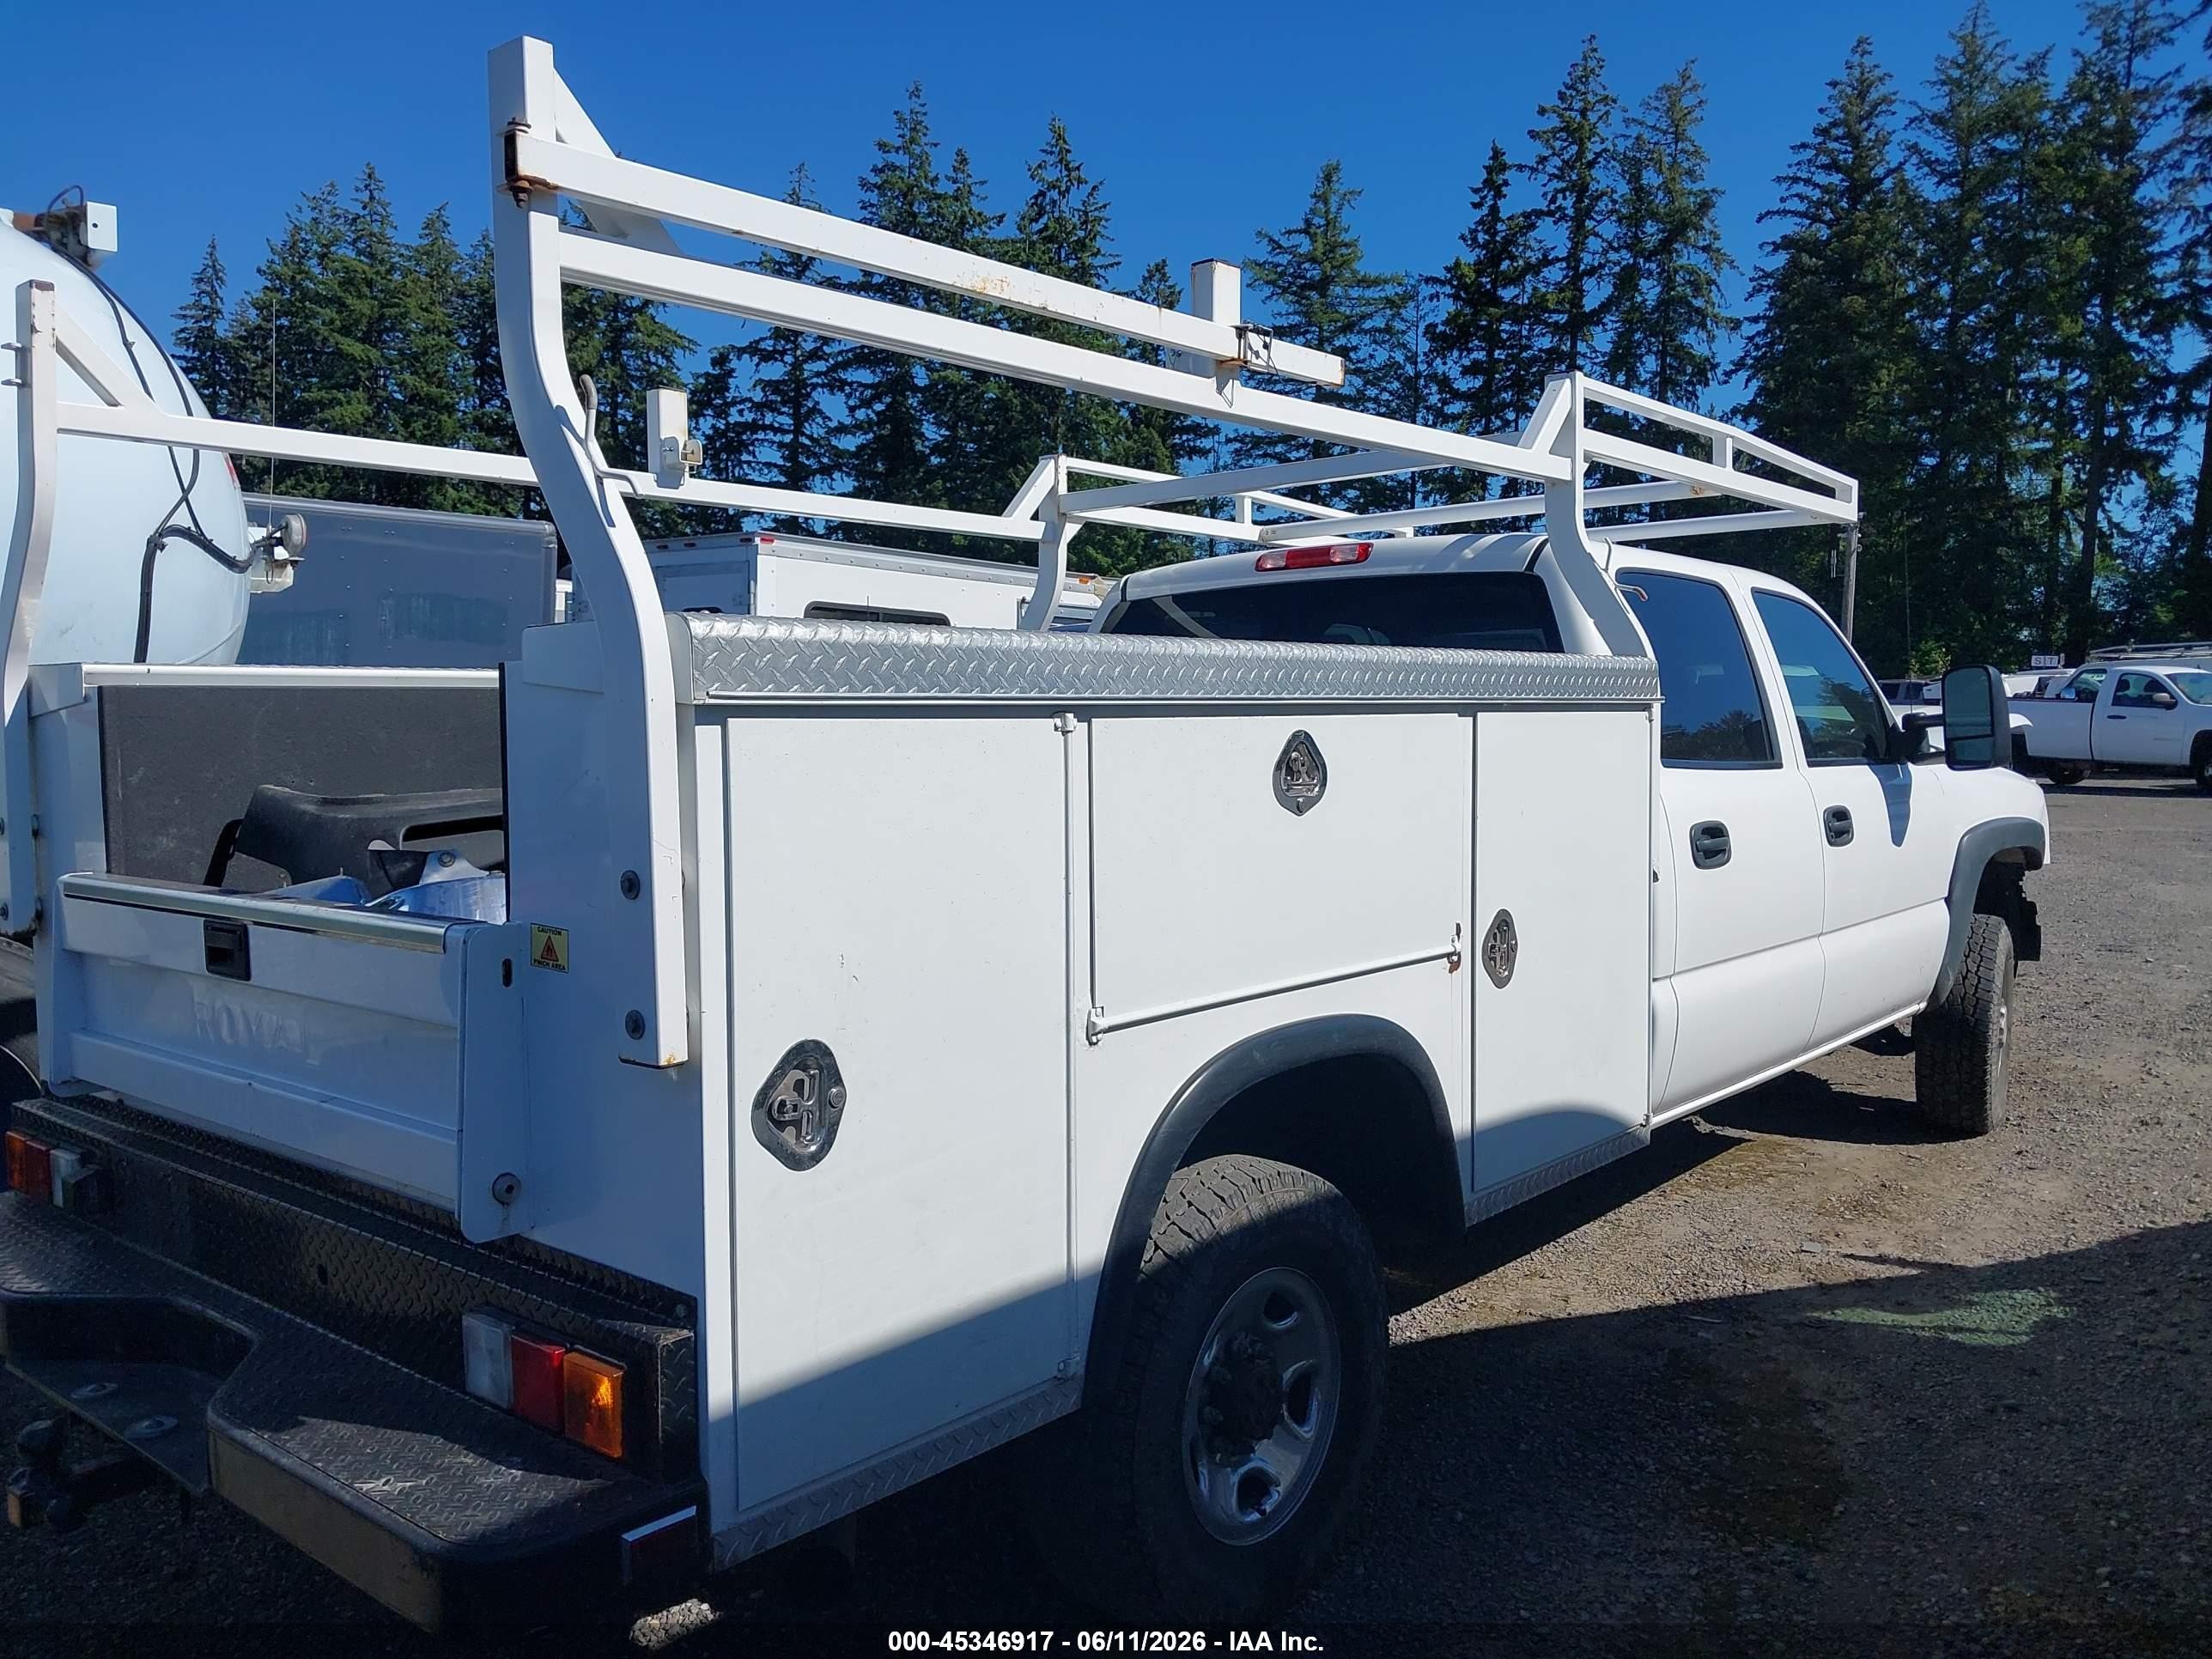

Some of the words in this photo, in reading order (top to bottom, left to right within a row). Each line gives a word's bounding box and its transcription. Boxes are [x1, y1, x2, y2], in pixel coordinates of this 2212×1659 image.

[537, 927, 562, 937] CAUTION
[533, 958, 550, 968] PINCH
[193, 1000, 319, 1066] ROYAL
